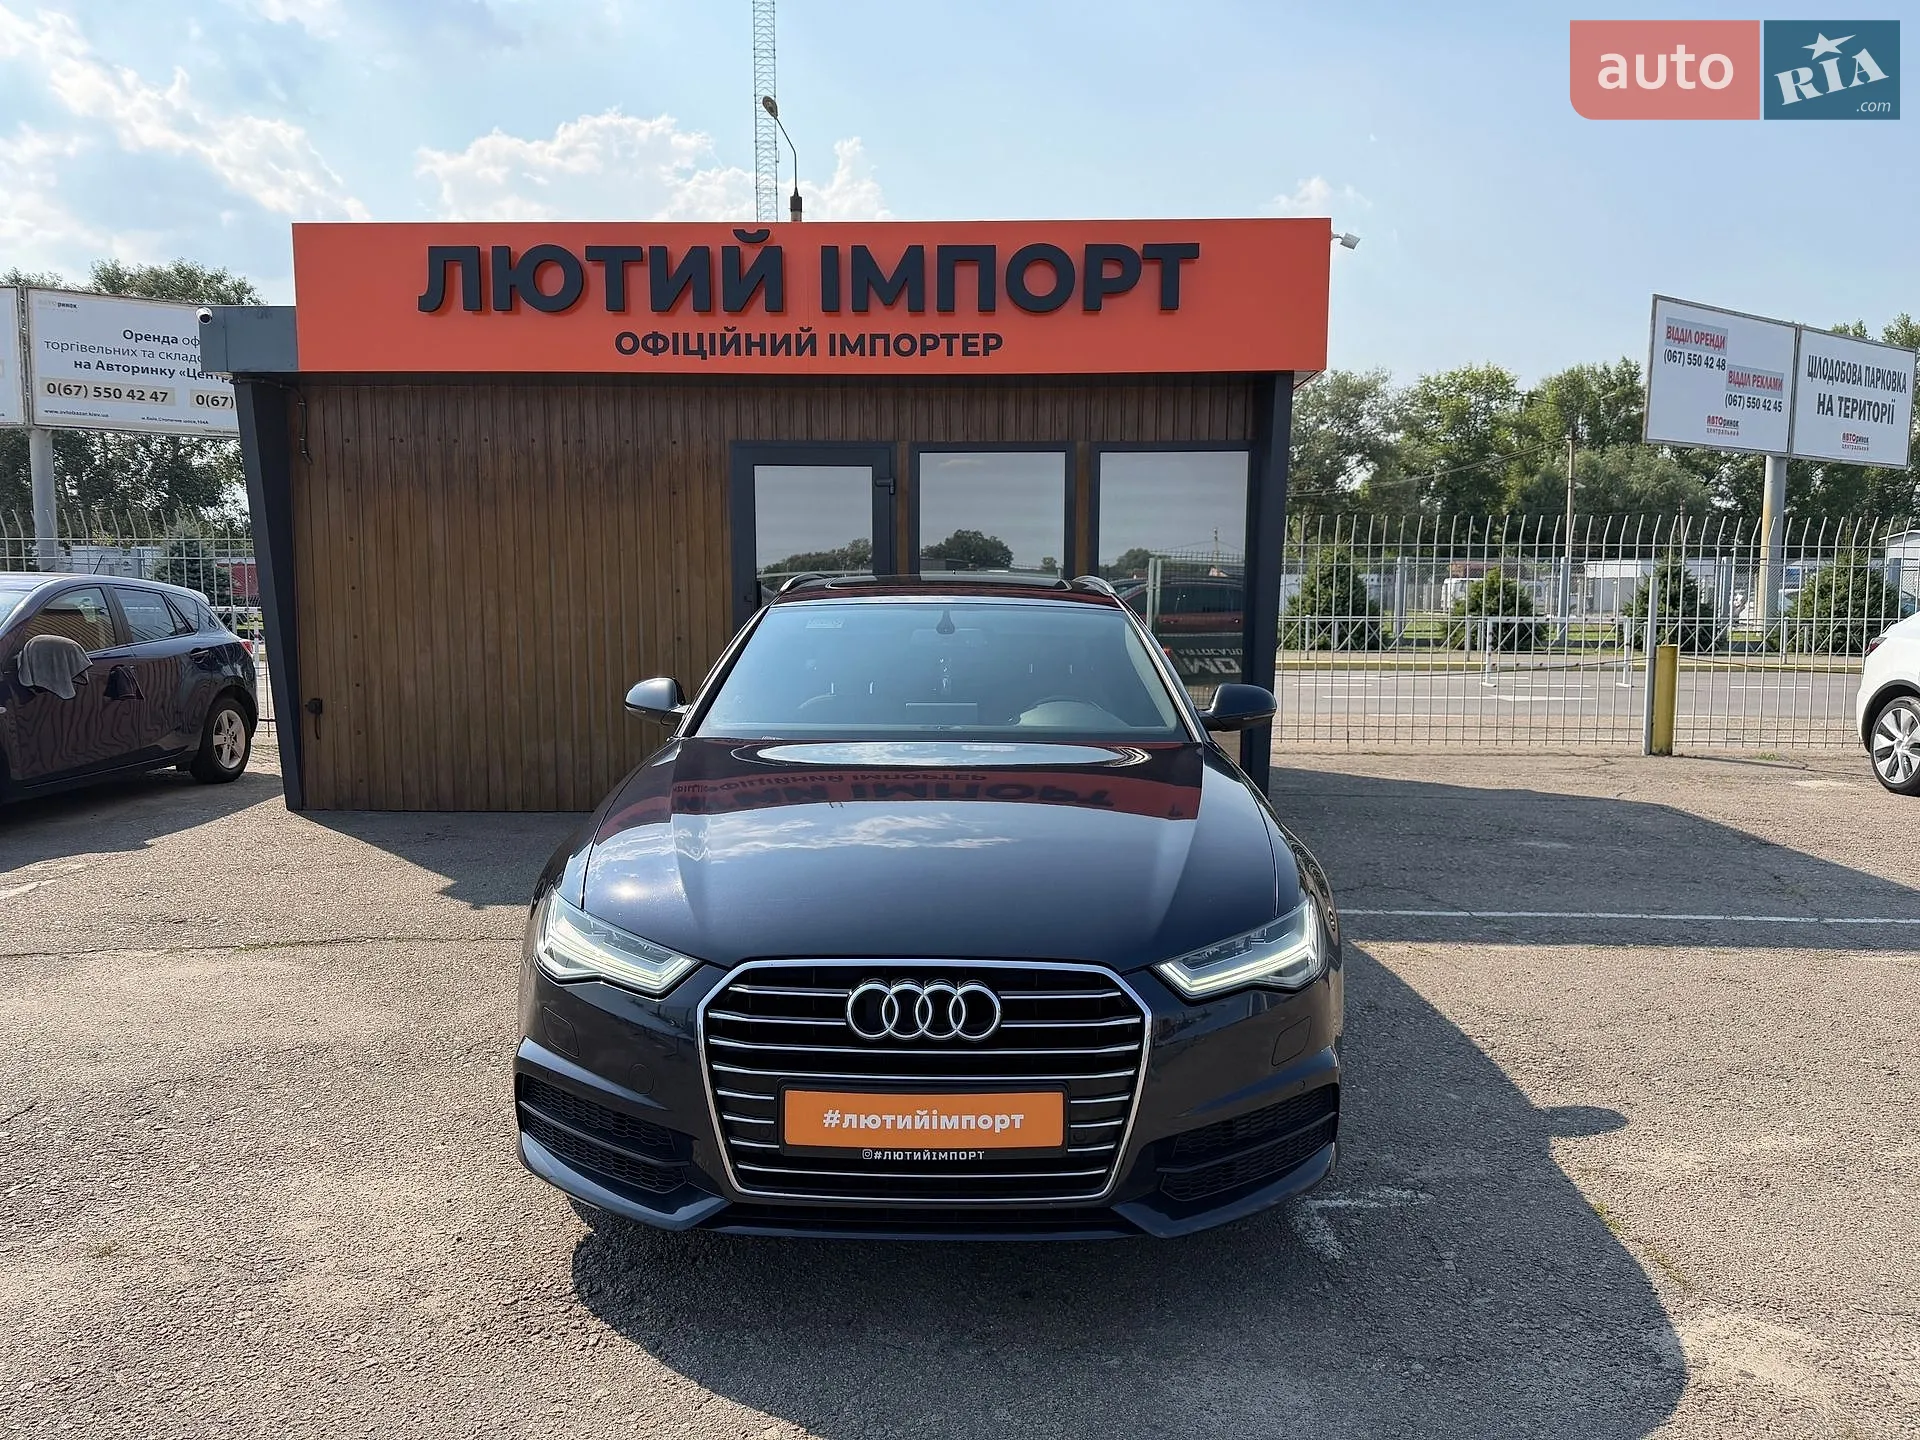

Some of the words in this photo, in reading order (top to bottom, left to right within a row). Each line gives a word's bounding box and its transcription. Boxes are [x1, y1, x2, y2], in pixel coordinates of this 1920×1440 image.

[418, 229, 784, 312] ЛЮТИЙ
[820, 243, 1200, 313] ІМПОРТ
[123, 329, 178, 345] Оренда
[614, 326, 817, 360] ОФІЦІЙНИЙ
[829, 332, 1003, 356] ІМПОРТЕР
[1665, 324, 1692, 344] ВІДДІЛ
[1694, 328, 1725, 350] ОРЕНДИ
[44, 338, 138, 358] торгівельних
[141, 349, 155, 359] та
[74, 360, 91, 370] на
[95, 361, 175, 379] Авторинку
[1664, 348, 1685, 367] (067)
[1687, 352, 1702, 367] 550
[1704, 355, 1715, 369] 42
[1716, 357, 1726, 371] 48
[1728, 370, 1750, 388] ВІДДІЛ
[1752, 374, 1783, 392] РЕКЛАМИ
[1807, 355, 1863, 387] ЦІЛОДОБОВА
[1864, 367, 1907, 394] ПАРКОВКА
[47, 382, 88, 399] 0(67)
[93, 387, 122, 400] 550
[126, 389, 146, 401] 42
[149, 391, 168, 402] 47
[195, 394, 234, 409] 0(67)
[1725, 393, 1745, 409] (067)
[1746, 396, 1760, 411] 550
[1761, 398, 1771, 411] 42
[1773, 399, 1783, 413] 45
[1817, 393, 1834, 417] НА
[1837, 396, 1894, 425] ТЕРИТОРІЇ
[1707, 415, 1739, 428] АВТОринок
[1842, 432, 1869, 444] АВТОринок
[823, 1109, 1024, 1132] #лютийімпорт
